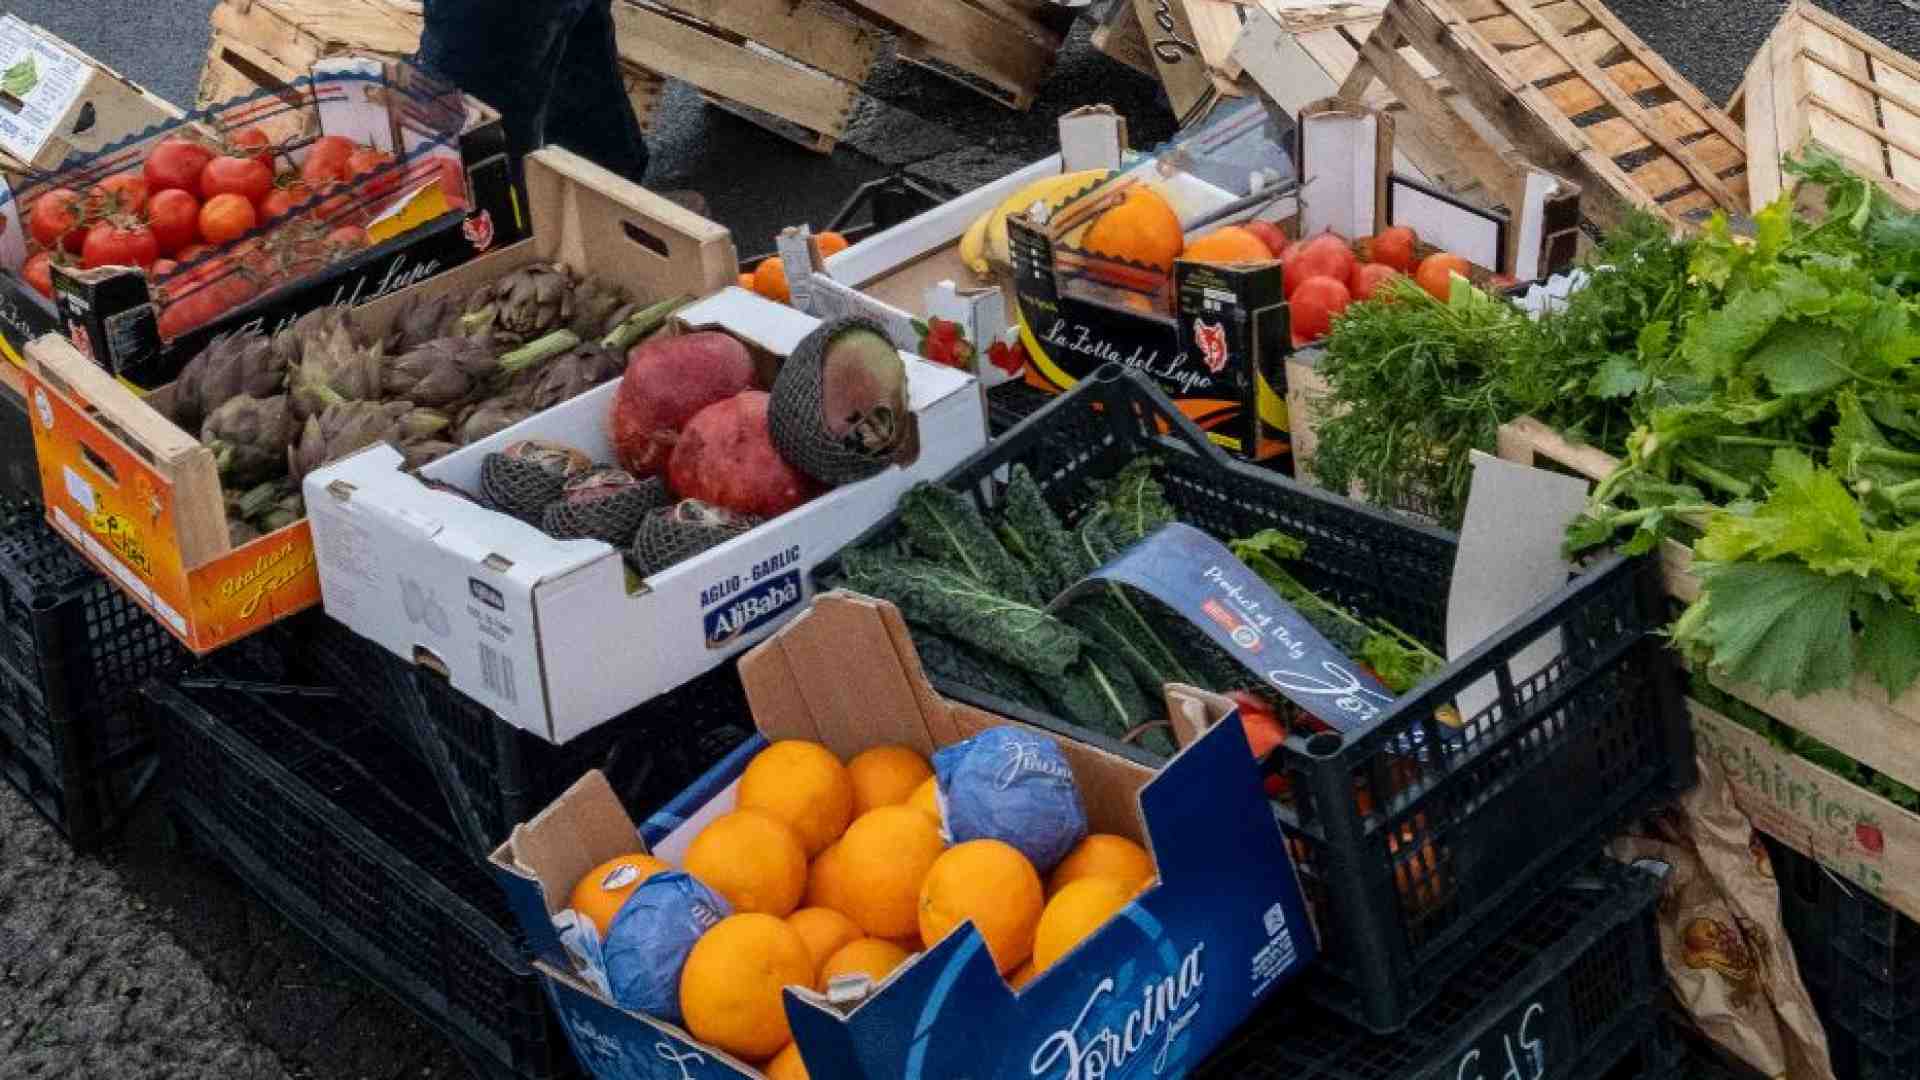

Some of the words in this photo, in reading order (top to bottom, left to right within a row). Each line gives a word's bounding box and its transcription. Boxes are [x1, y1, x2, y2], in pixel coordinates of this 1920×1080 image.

[1154, 352, 1211, 394] Lupo
[700, 576, 741, 607] AGLIO
[752, 545, 800, 580] GARLIC
[1203, 566, 1259, 616] Product
